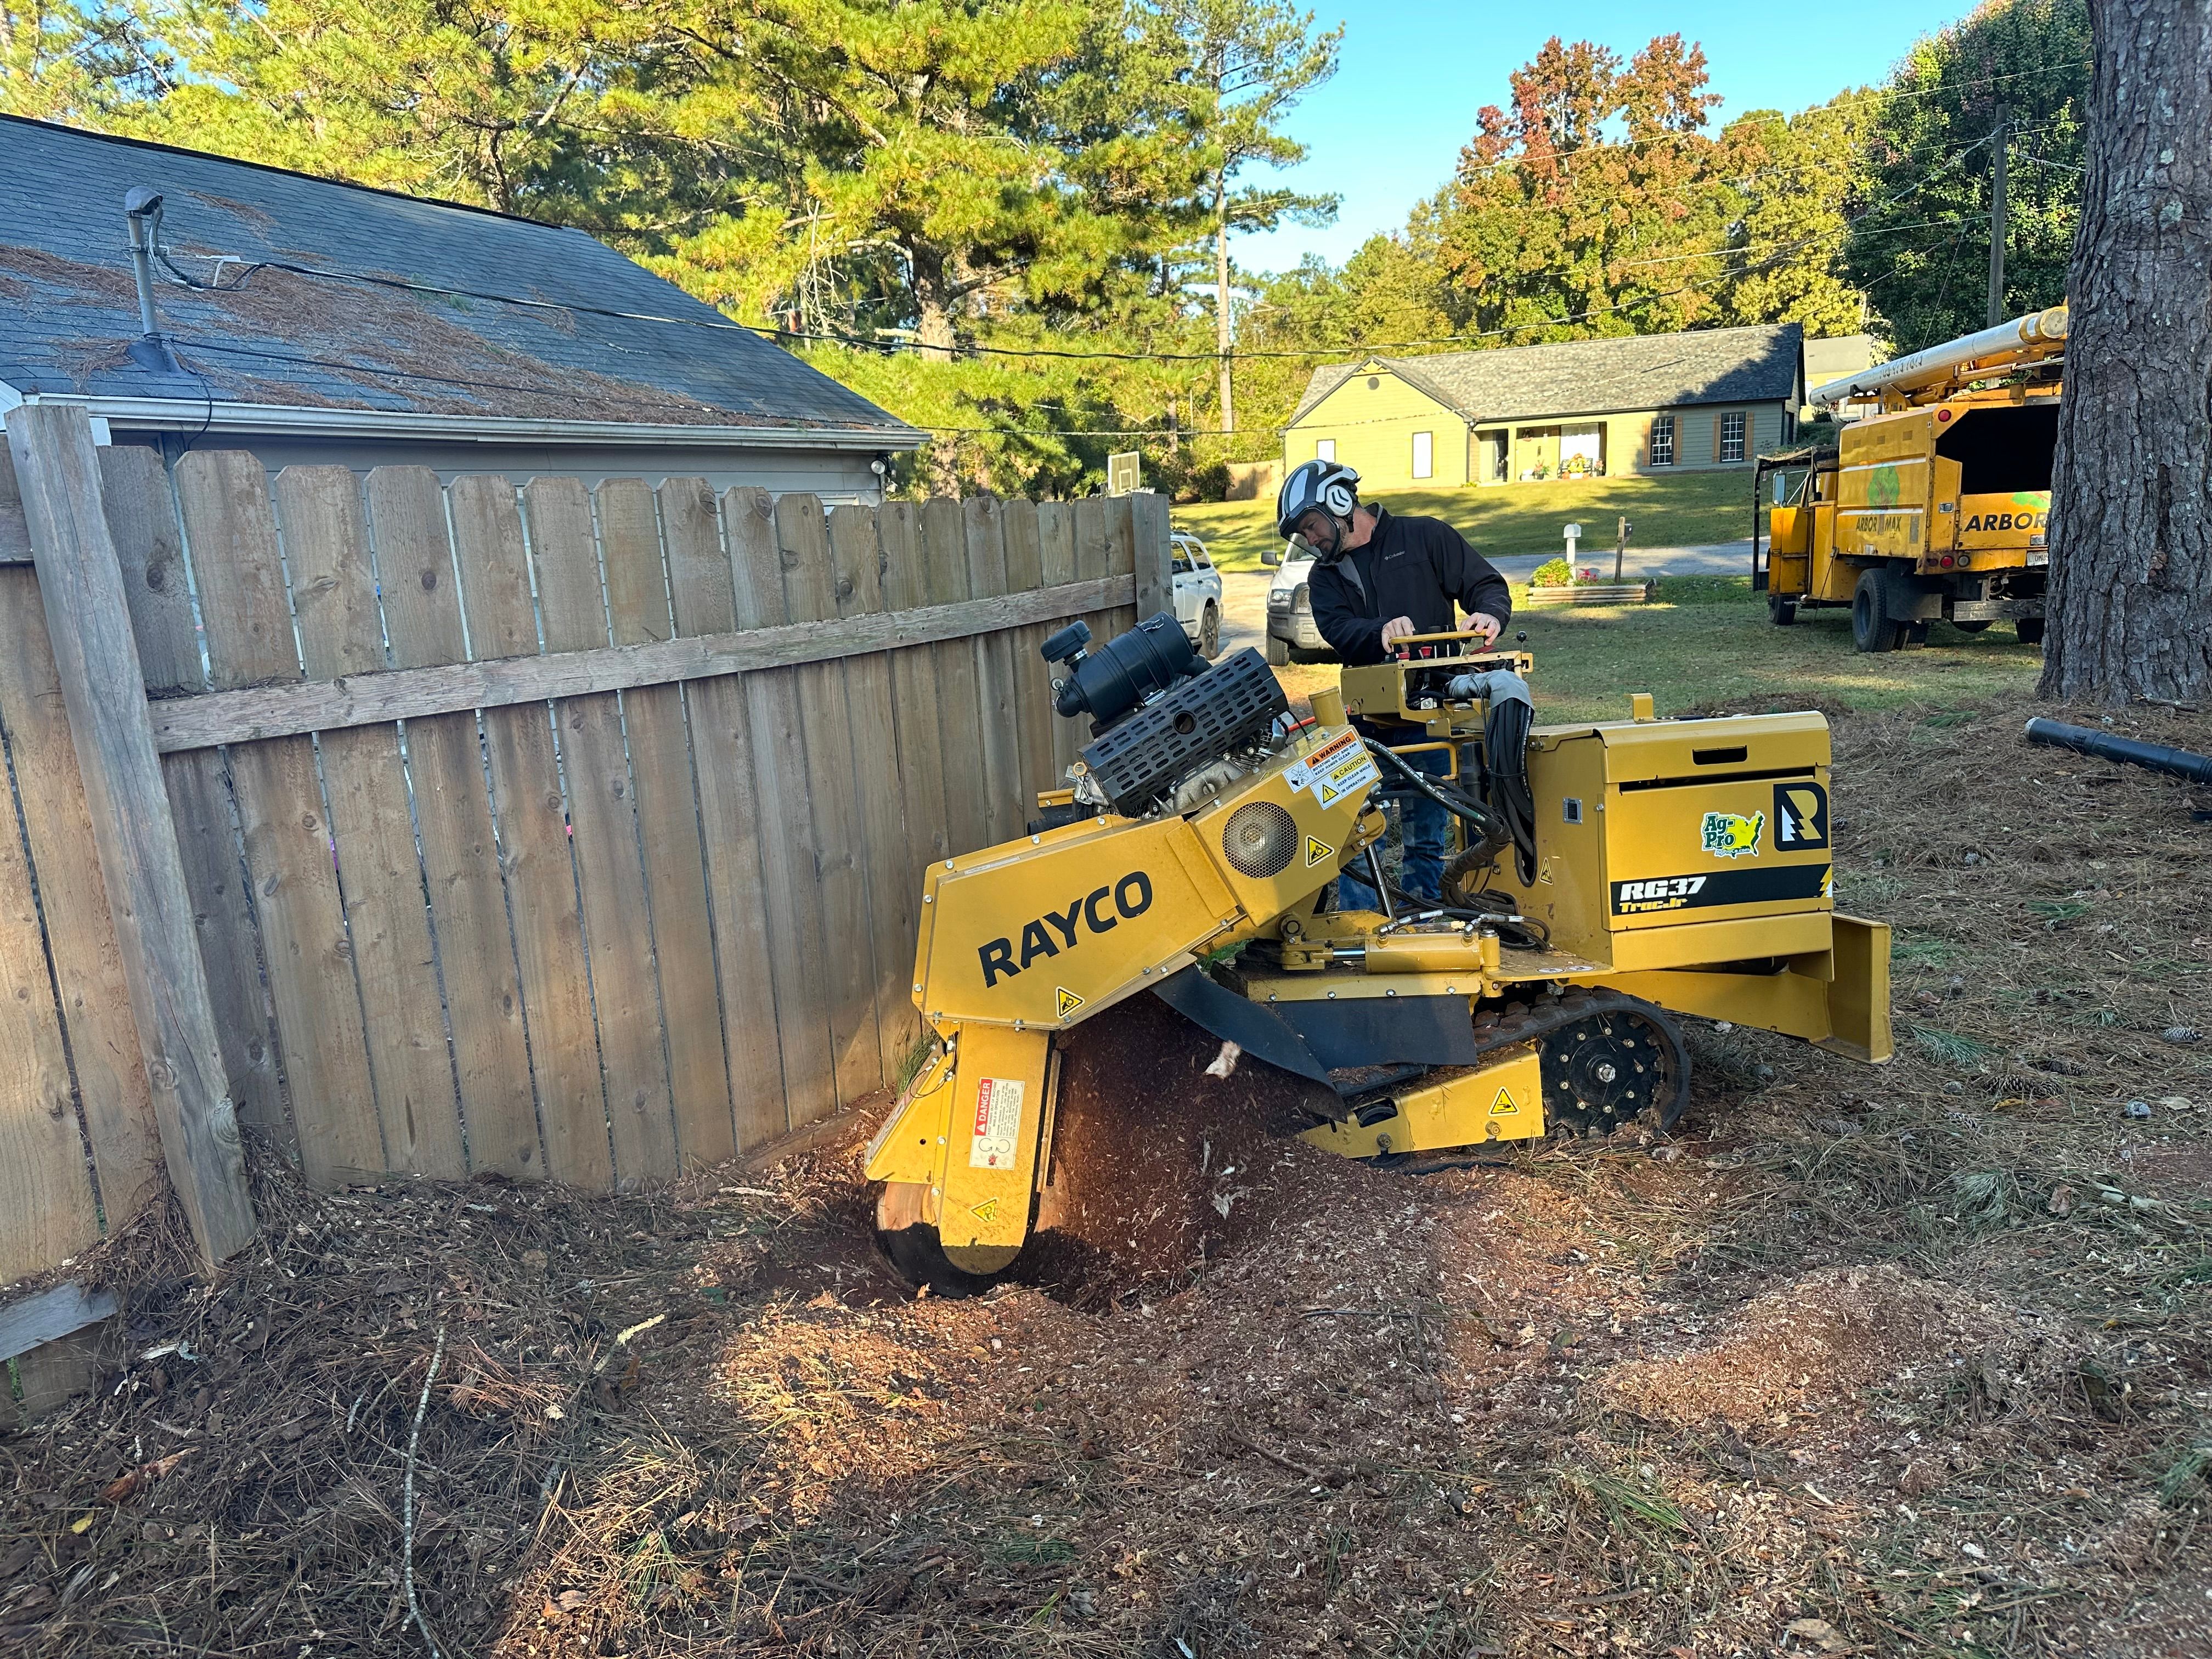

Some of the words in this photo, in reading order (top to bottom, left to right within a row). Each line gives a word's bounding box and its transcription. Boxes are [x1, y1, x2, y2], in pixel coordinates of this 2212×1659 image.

[1856, 516, 1877, 532] ARBOR
[1884, 516, 1902, 532] MAX
[1963, 512, 2047, 532] ARBOR
[1319, 736, 1352, 759] WARNING
[1313, 758, 1331, 772] ROTATING
[1325, 759, 1339, 770] HANDS
[1339, 752, 1351, 761] CLEAR
[1339, 755, 1367, 775] CAUTION
[1338, 778, 1347, 787] KEEP
[1347, 771, 1360, 781] CLEAR
[1359, 764, 1371, 773] WHILE
[1346, 775, 1367, 789] OPERATION
[1704, 815, 1734, 834] Ag-
[1705, 832, 1735, 848] Pro
[1620, 876, 1707, 901] RG37
[978, 871, 1153, 988] RAYCO
[978, 1082, 991, 1121] DANGER
